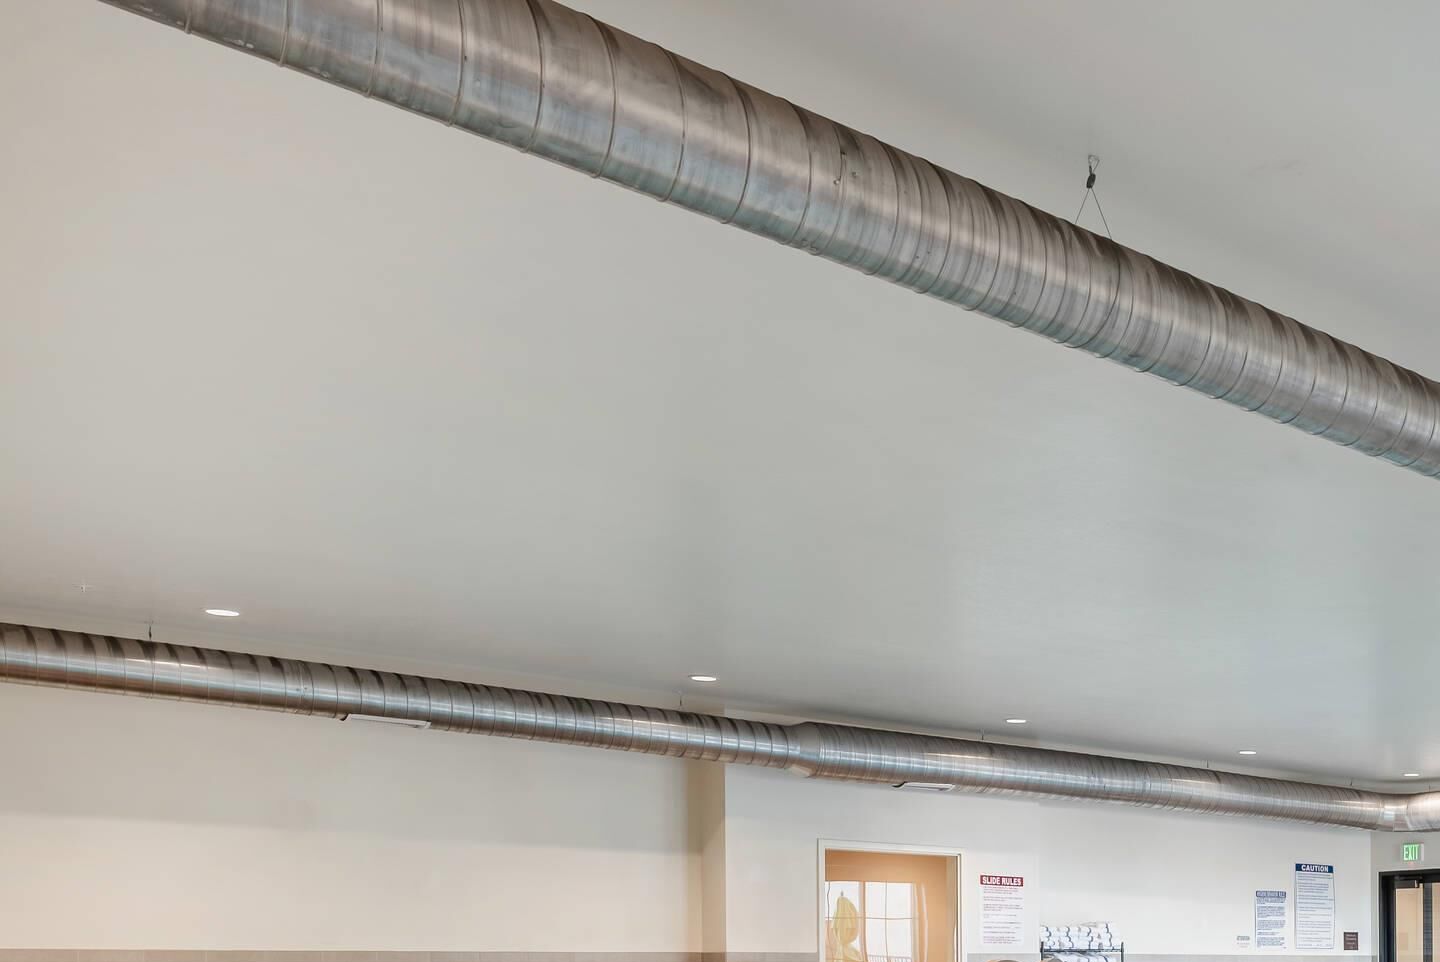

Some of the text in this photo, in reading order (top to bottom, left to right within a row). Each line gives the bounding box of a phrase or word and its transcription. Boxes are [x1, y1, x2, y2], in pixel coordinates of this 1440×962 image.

[1403, 844, 1419, 861] EXIT
[1301, 864, 1328, 872] CAUTION
[982, 876, 1021, 886] SLIDE RULES
